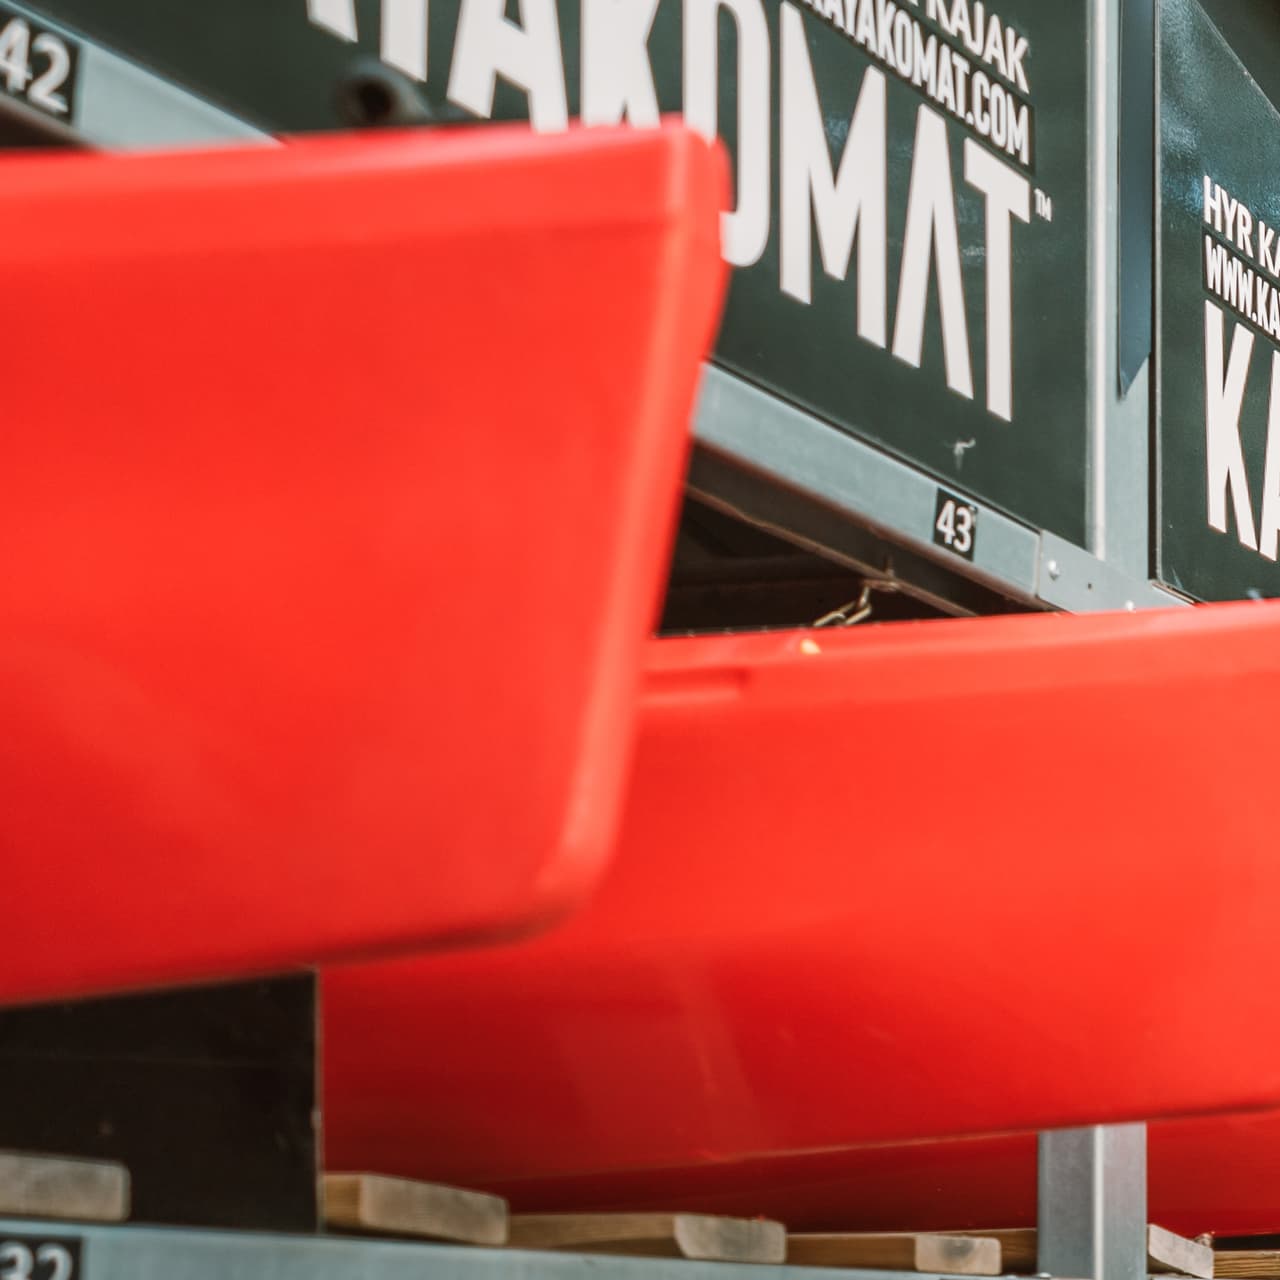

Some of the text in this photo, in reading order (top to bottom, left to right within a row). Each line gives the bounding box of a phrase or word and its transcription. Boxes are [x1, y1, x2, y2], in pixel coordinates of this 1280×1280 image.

[0, 16, 69, 113] 42
[1203, 175, 1254, 258] HYR
[936, 499, 972, 552] 43
